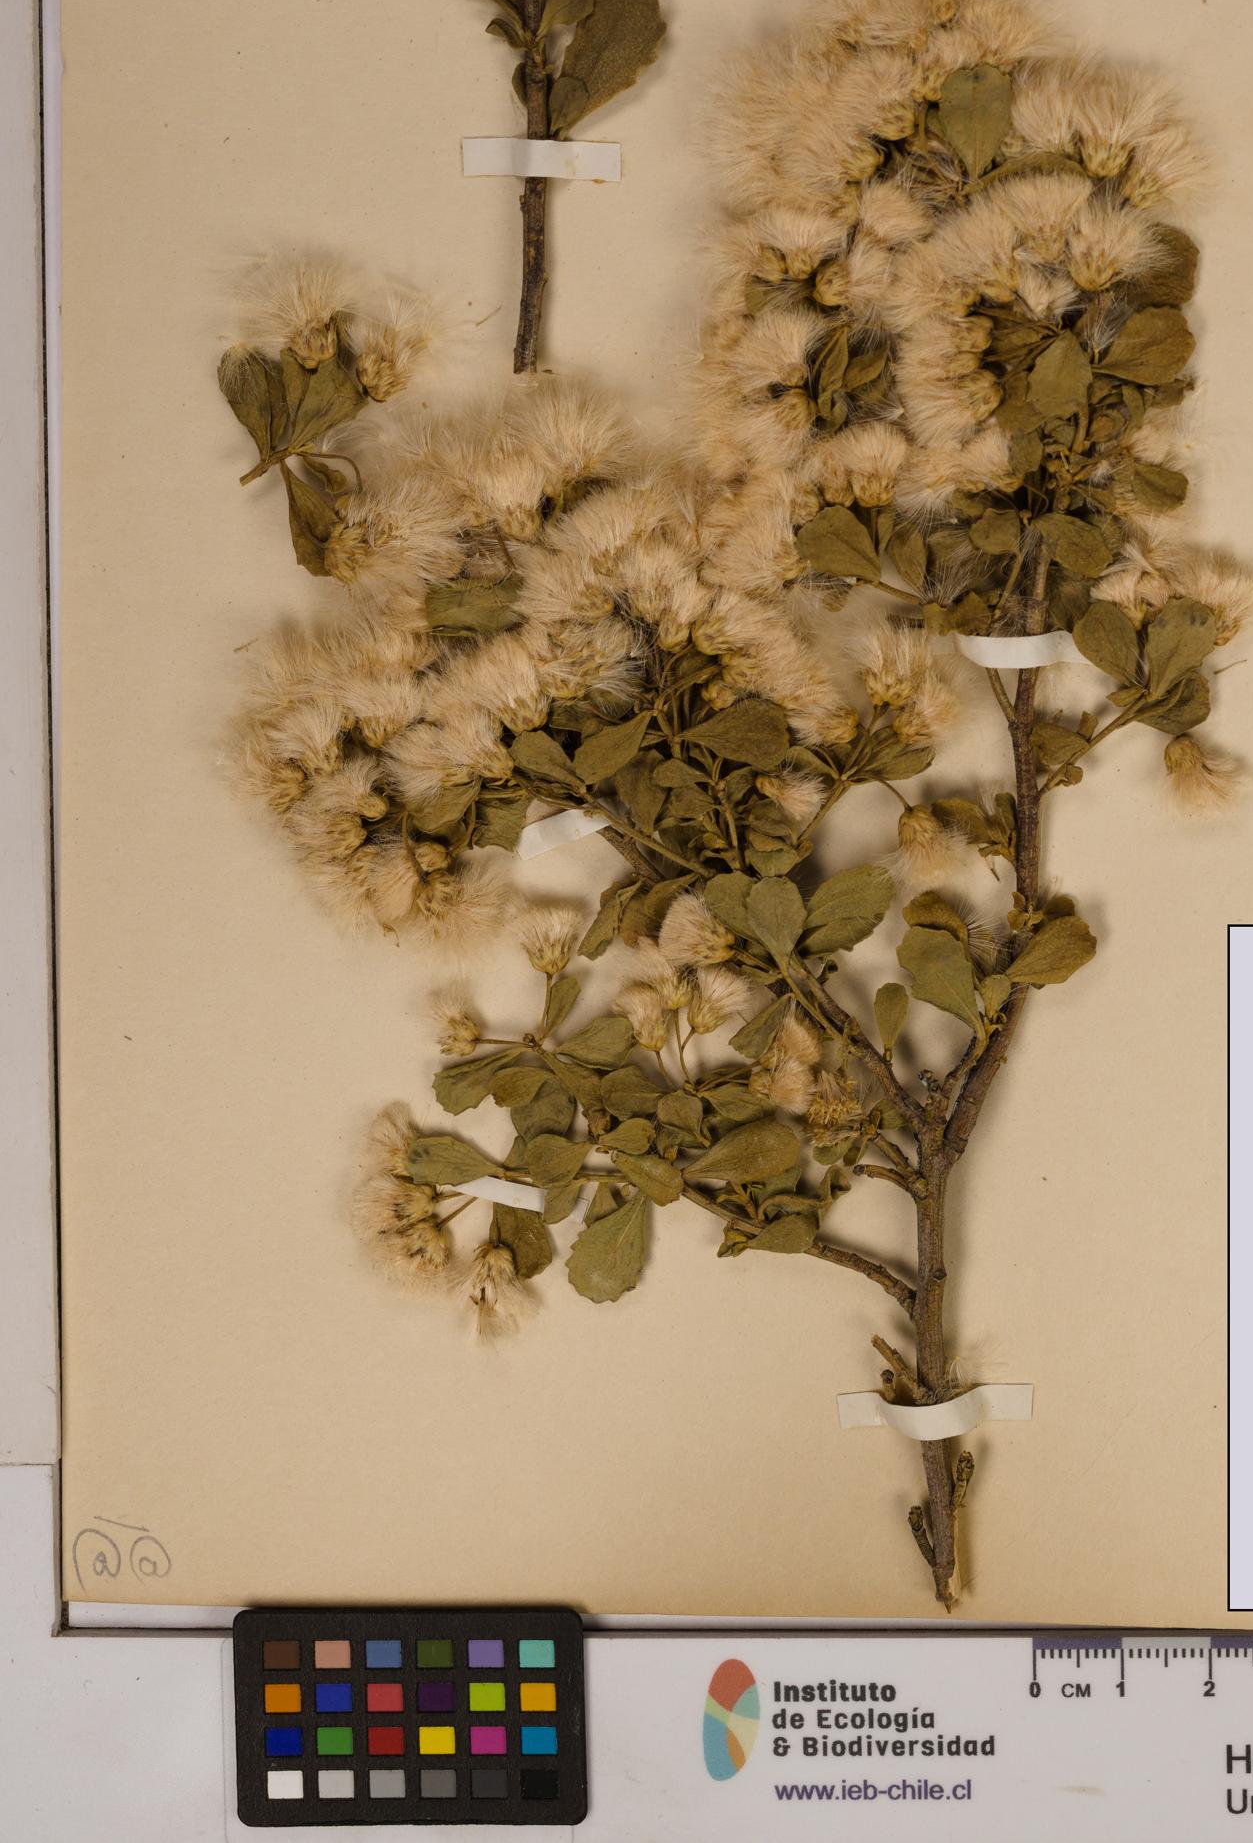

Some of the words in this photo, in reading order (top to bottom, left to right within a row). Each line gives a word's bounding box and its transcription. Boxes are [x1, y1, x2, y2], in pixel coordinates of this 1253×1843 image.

[773, 1679, 897, 1703] Instituto
[1029, 1680, 1042, 1699] 0
[1061, 1683, 1091, 1698] CM
[1115, 1680, 1125, 1698] 1
[1203, 1680, 1216, 1698] 2
[771, 1708, 805, 1730] de
[816, 1707, 935, 1733] Ecología
[773, 1736, 791, 1757] &
[802, 1734, 995, 1757] Biodiversidad
[774, 1779, 972, 1801] www.ieb-chile.cl
